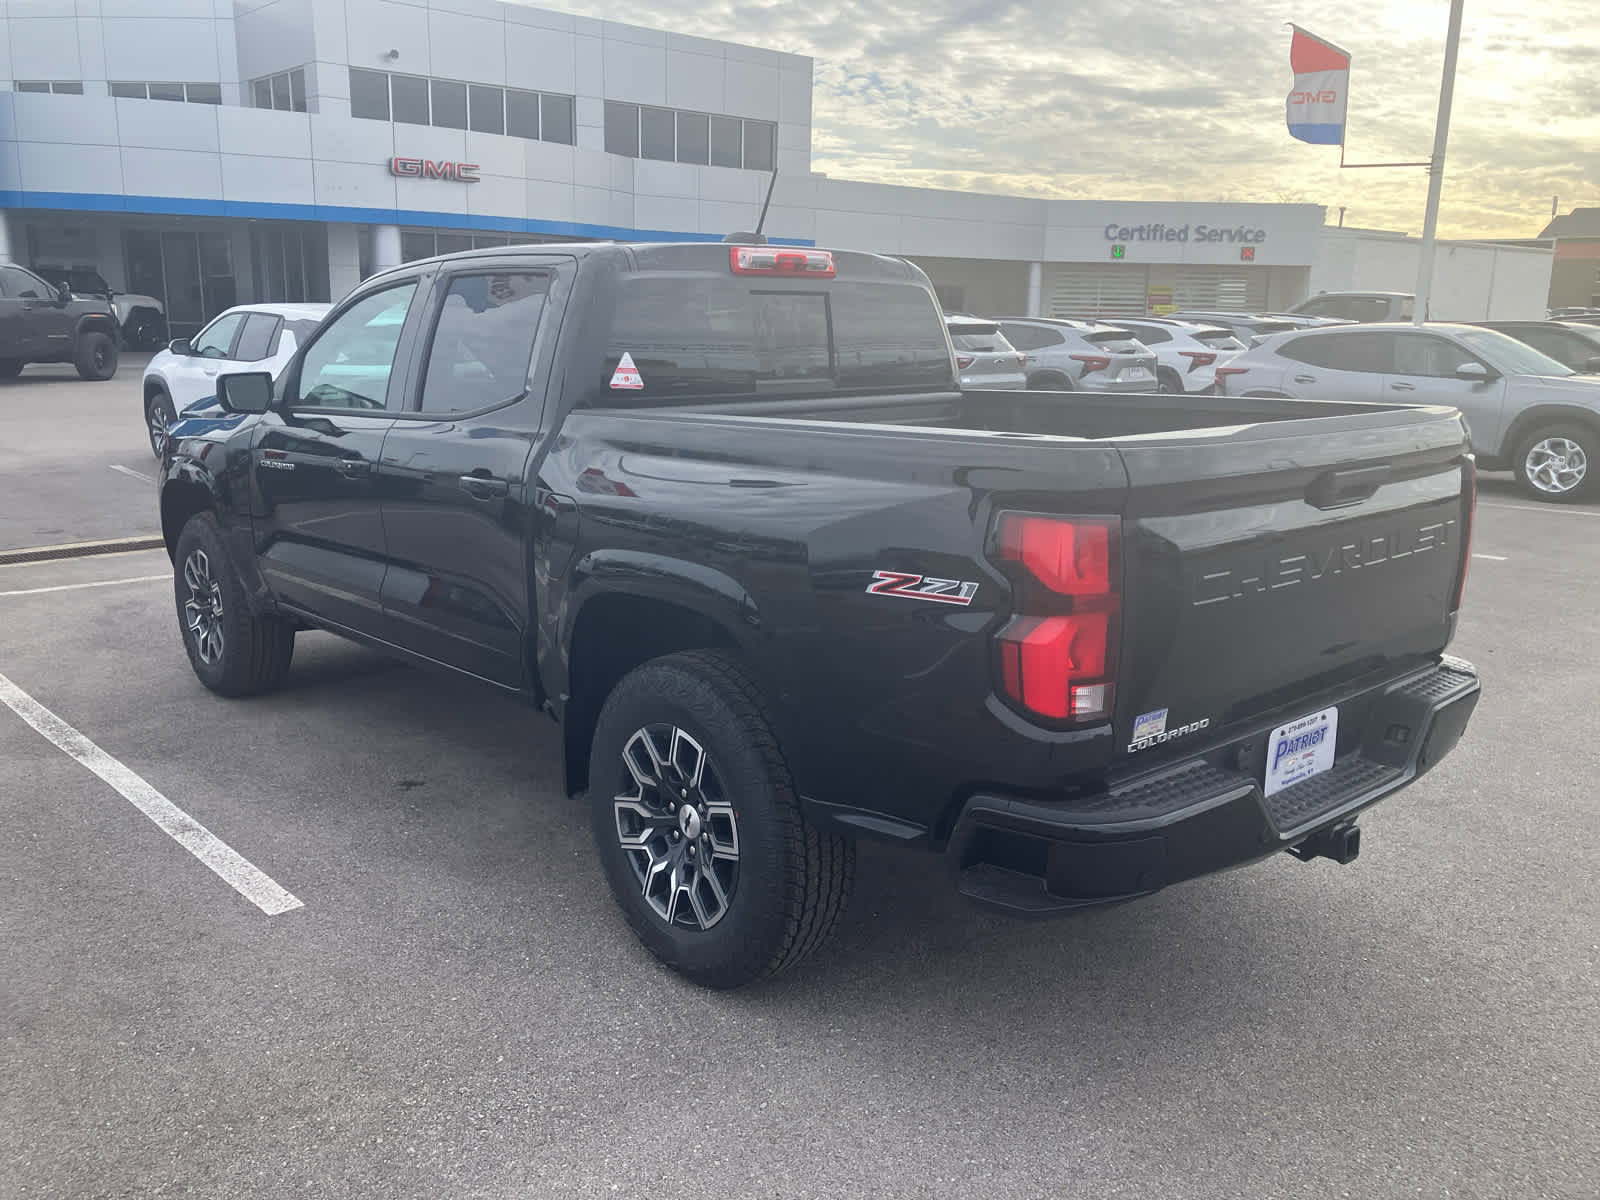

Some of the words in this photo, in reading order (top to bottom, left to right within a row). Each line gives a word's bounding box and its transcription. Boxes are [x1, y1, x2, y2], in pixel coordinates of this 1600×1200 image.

[391, 157, 480, 182] GMC
[1104, 223, 1190, 242] Certified
[1194, 225, 1267, 243] Service
[1193, 519, 1456, 607] CHEVROLET
[865, 569, 979, 606] Z71
[1127, 718, 1210, 753] COLORADO
[1272, 726, 1329, 771] PATRIOT
